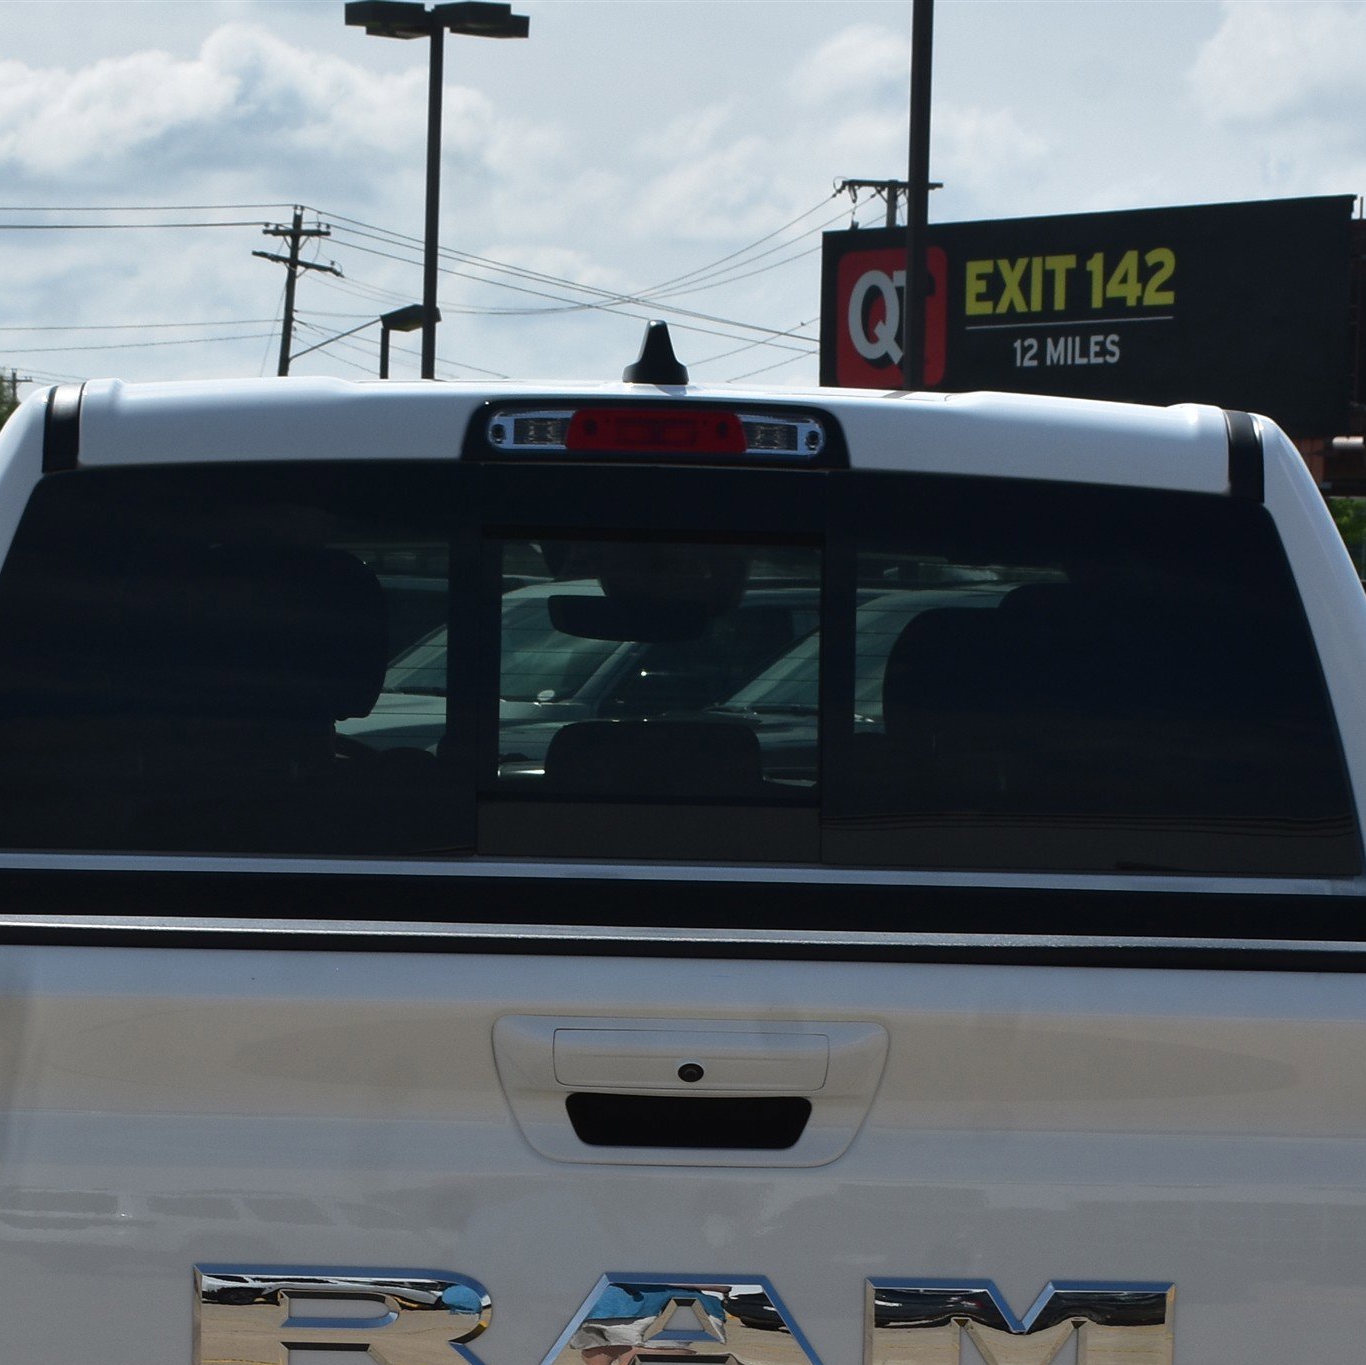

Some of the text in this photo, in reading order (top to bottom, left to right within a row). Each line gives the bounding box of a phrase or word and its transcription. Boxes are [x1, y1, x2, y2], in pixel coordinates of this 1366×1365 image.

[965, 248, 1176, 315] EXIT 142
[1014, 334, 1120, 367] 12 MILES
